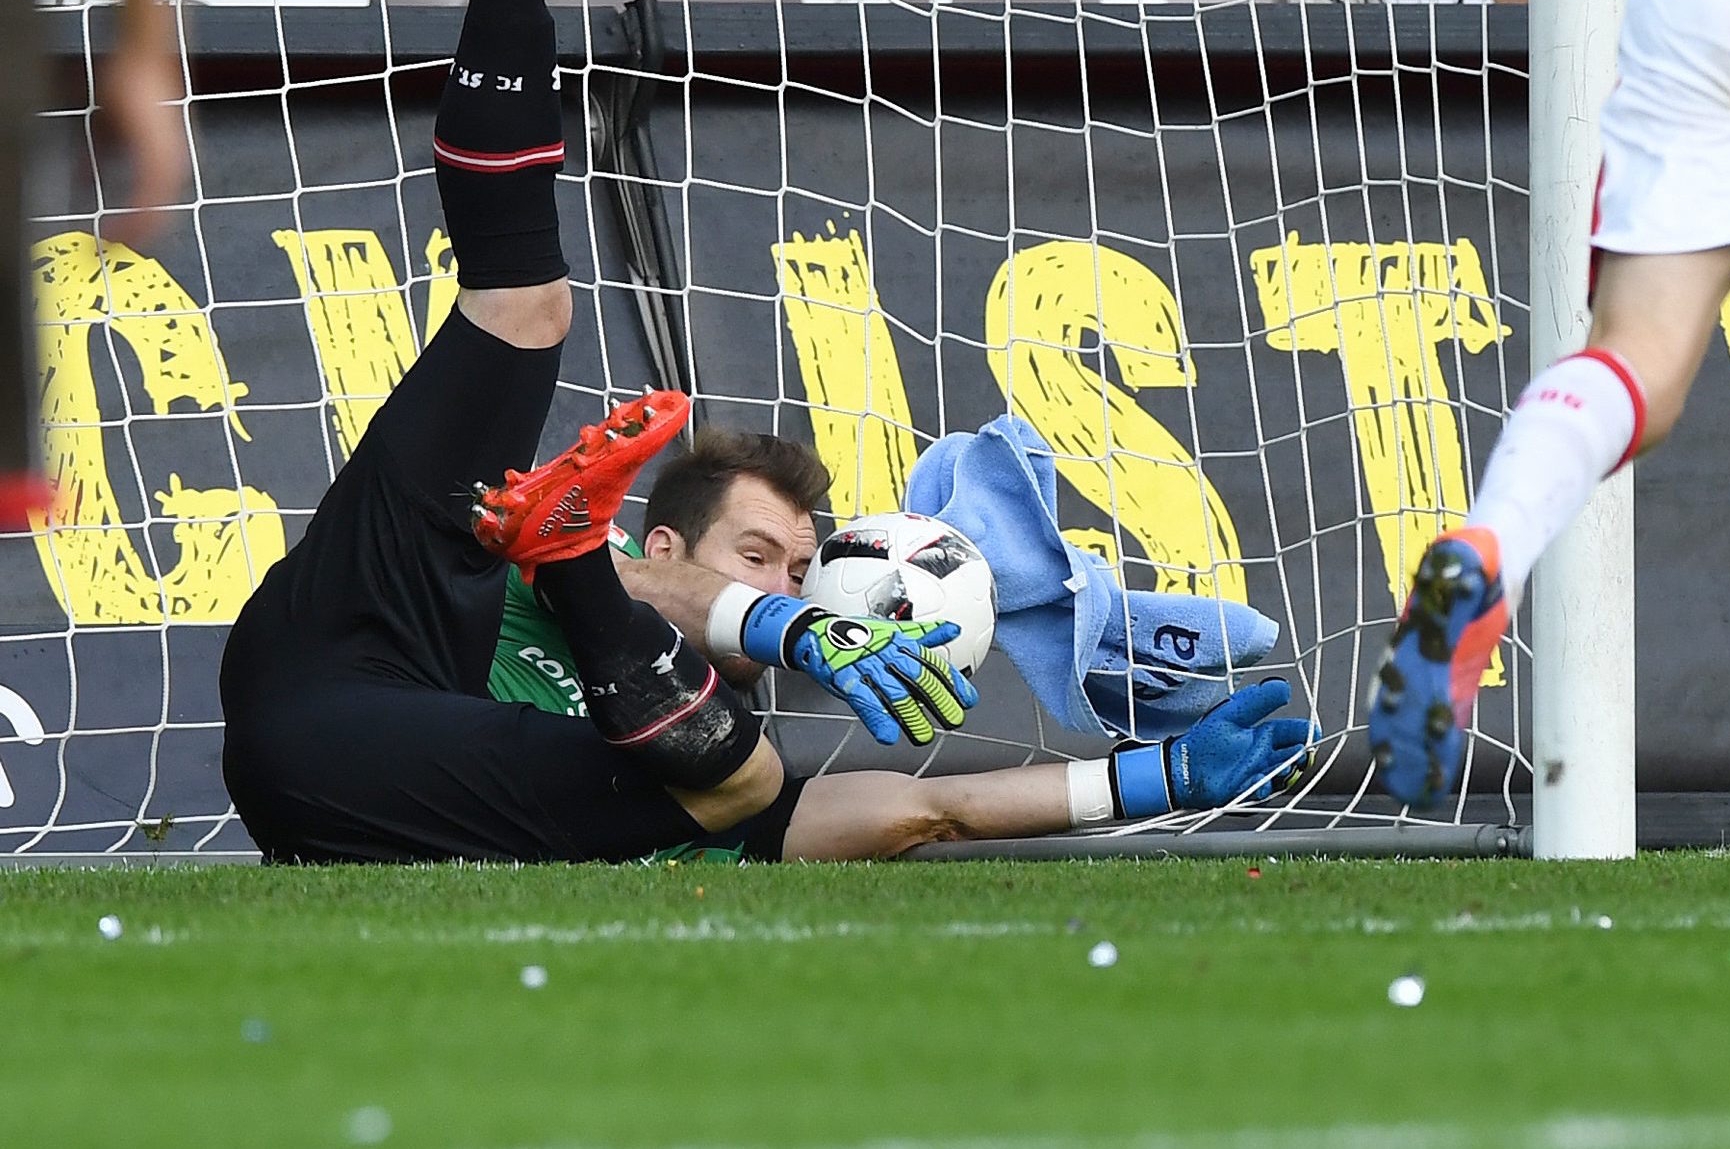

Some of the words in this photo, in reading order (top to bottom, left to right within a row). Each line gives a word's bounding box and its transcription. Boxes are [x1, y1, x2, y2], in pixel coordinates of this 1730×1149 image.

[495, 75, 523, 92] FC
[773, 214, 1513, 688] IST
[538, 484, 583, 538] adidas
